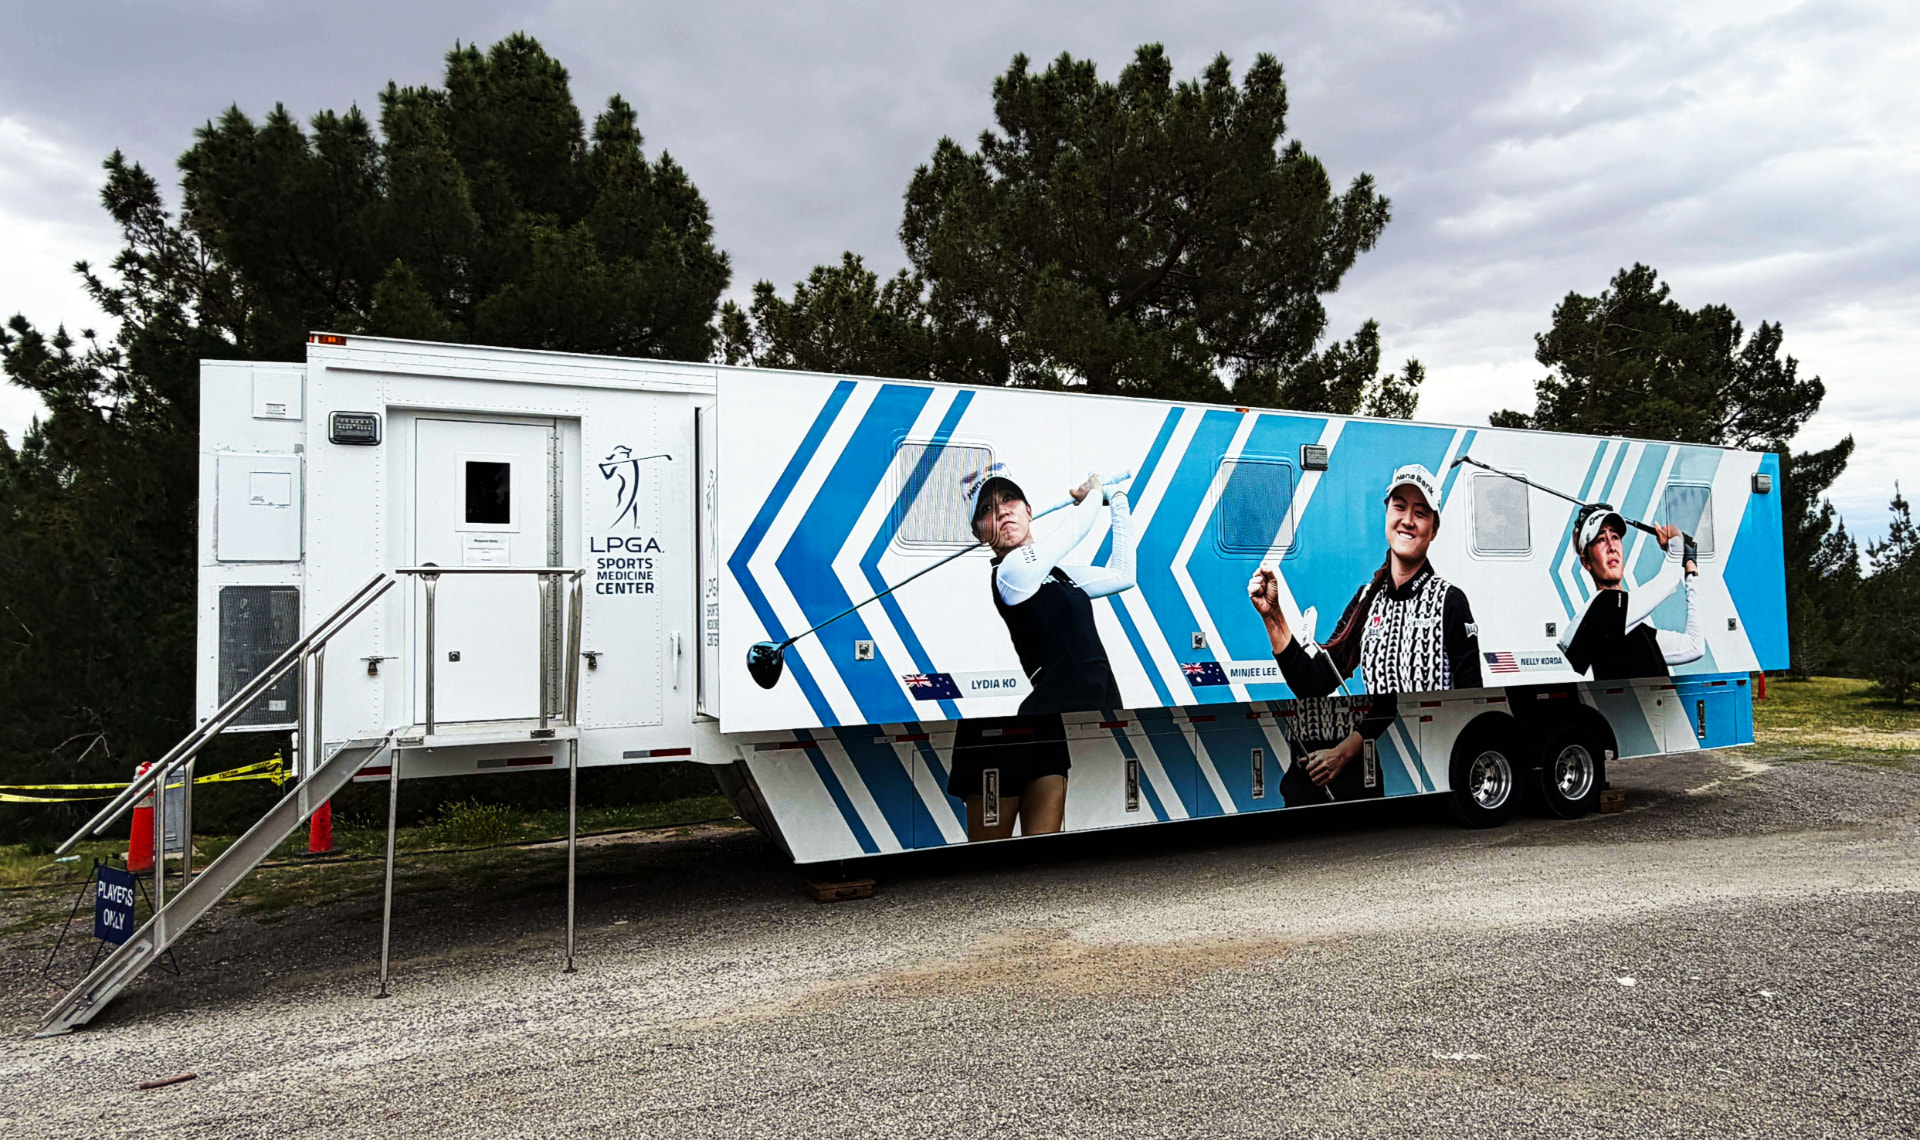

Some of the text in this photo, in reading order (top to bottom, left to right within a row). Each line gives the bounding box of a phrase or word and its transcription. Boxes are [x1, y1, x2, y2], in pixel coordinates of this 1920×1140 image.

[590, 536, 661, 553] LPGA
[597, 558, 653, 569] SPORTS
[597, 571, 654, 580] MEDICINE
[596, 582, 654, 594] CENTER
[1520, 656, 1562, 666] NELLY KORDA
[1230, 667, 1277, 677] MINJEE LEE
[971, 678, 1016, 690] LYDIA KO
[97, 880, 133, 907] PLAYERS
[103, 908, 125, 930] ONLY
